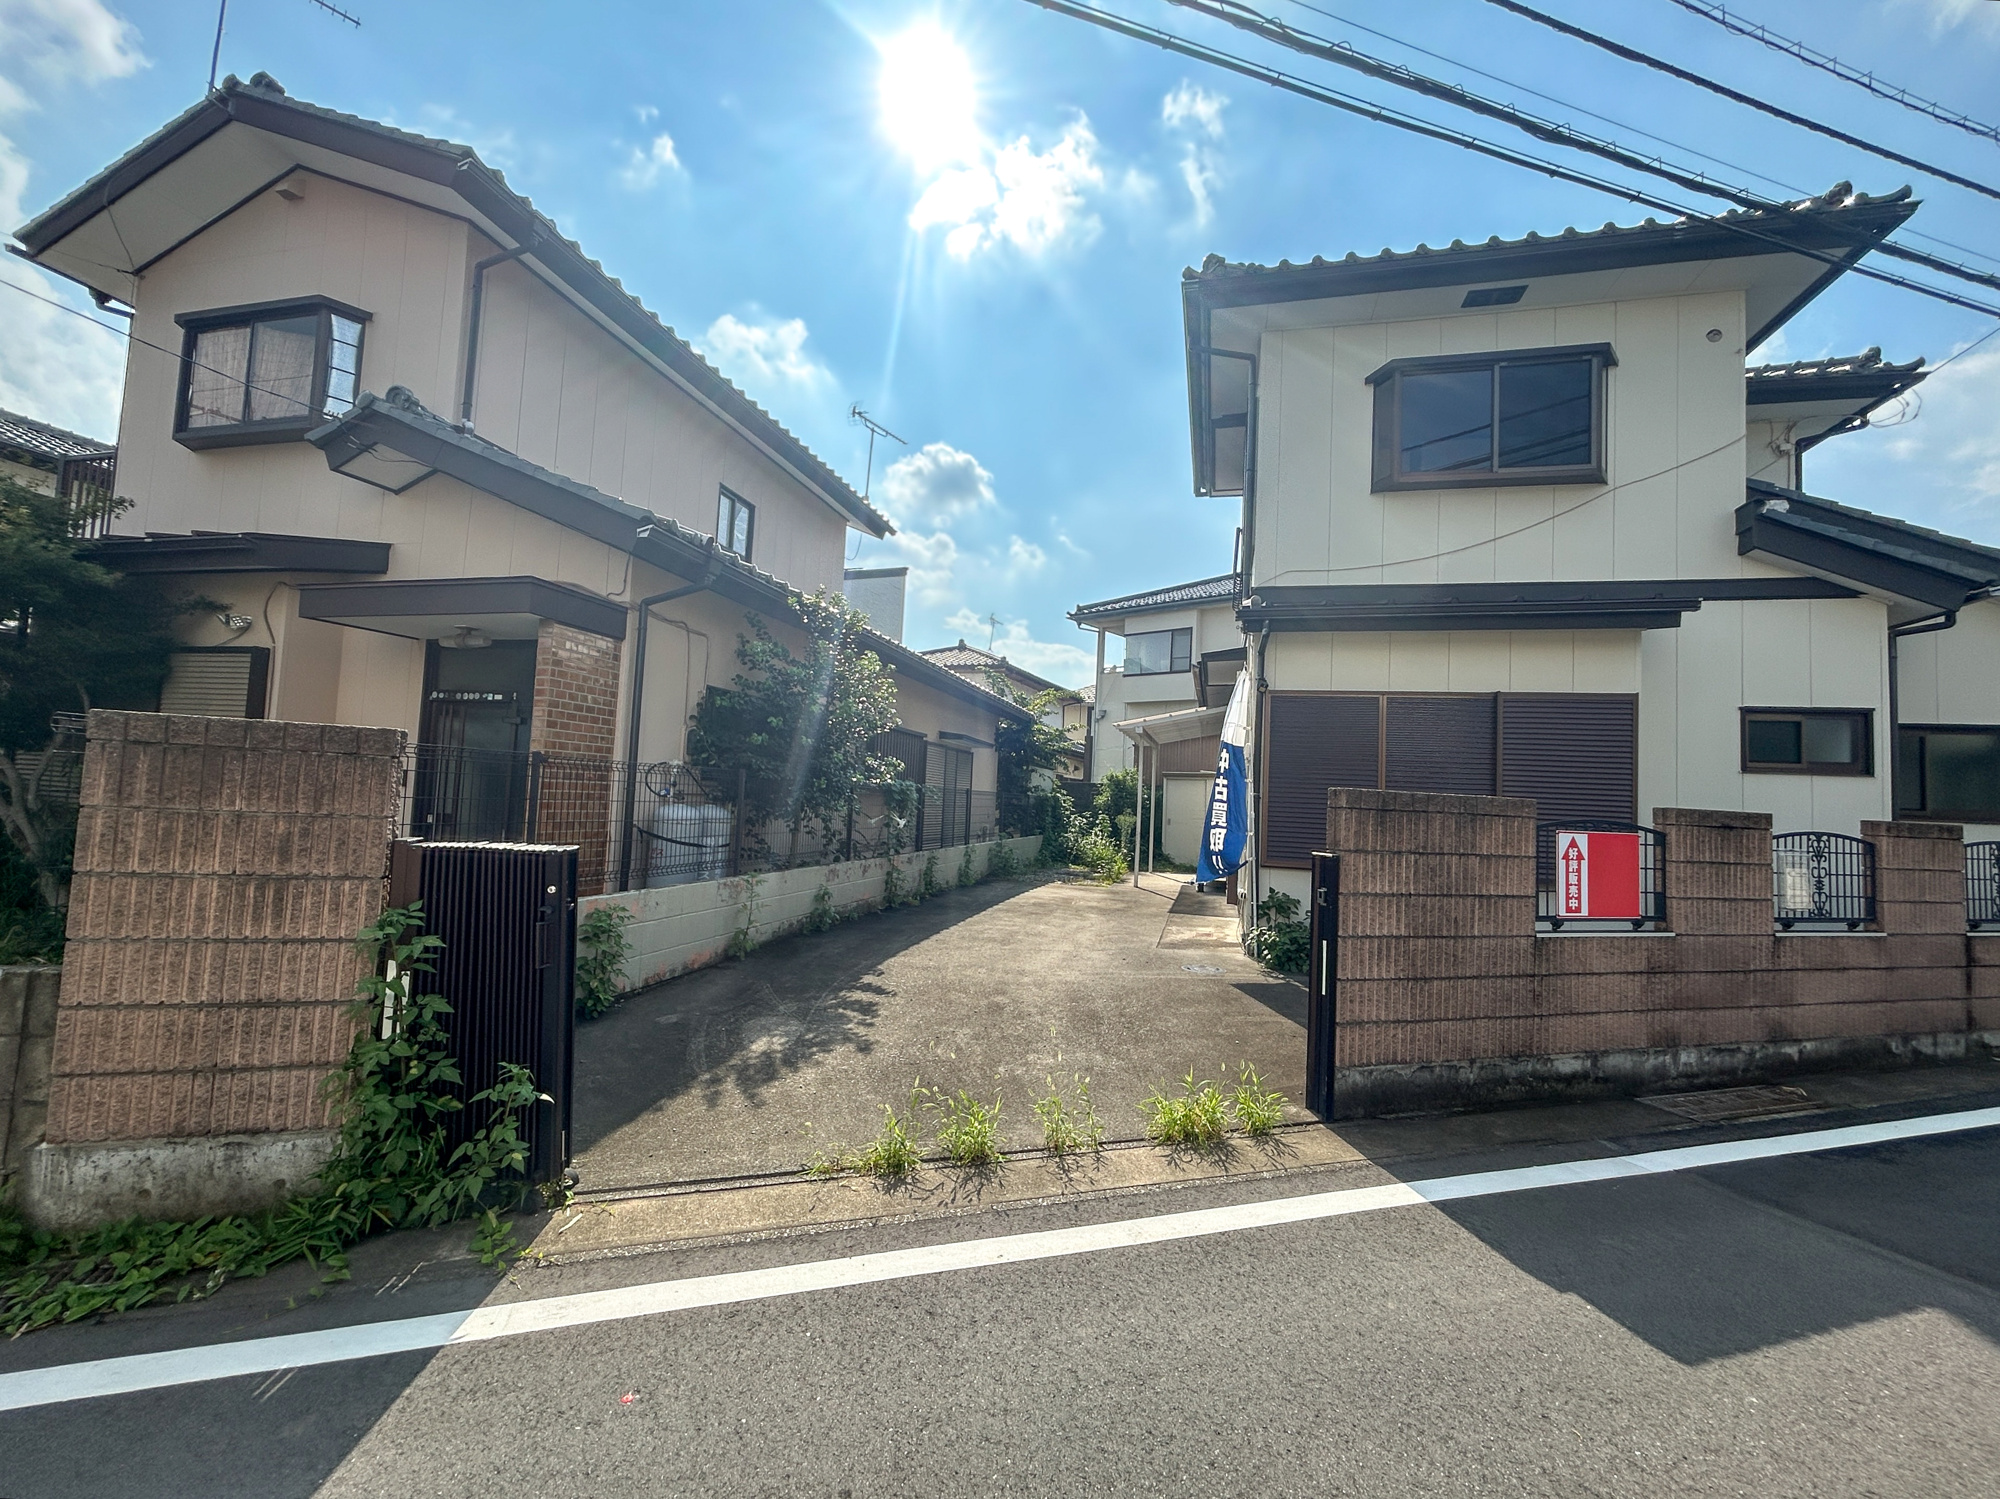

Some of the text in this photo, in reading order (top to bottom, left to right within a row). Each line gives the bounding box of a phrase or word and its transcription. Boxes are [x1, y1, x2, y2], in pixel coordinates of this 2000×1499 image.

[1568, 847, 1579, 909] 好評販売中
